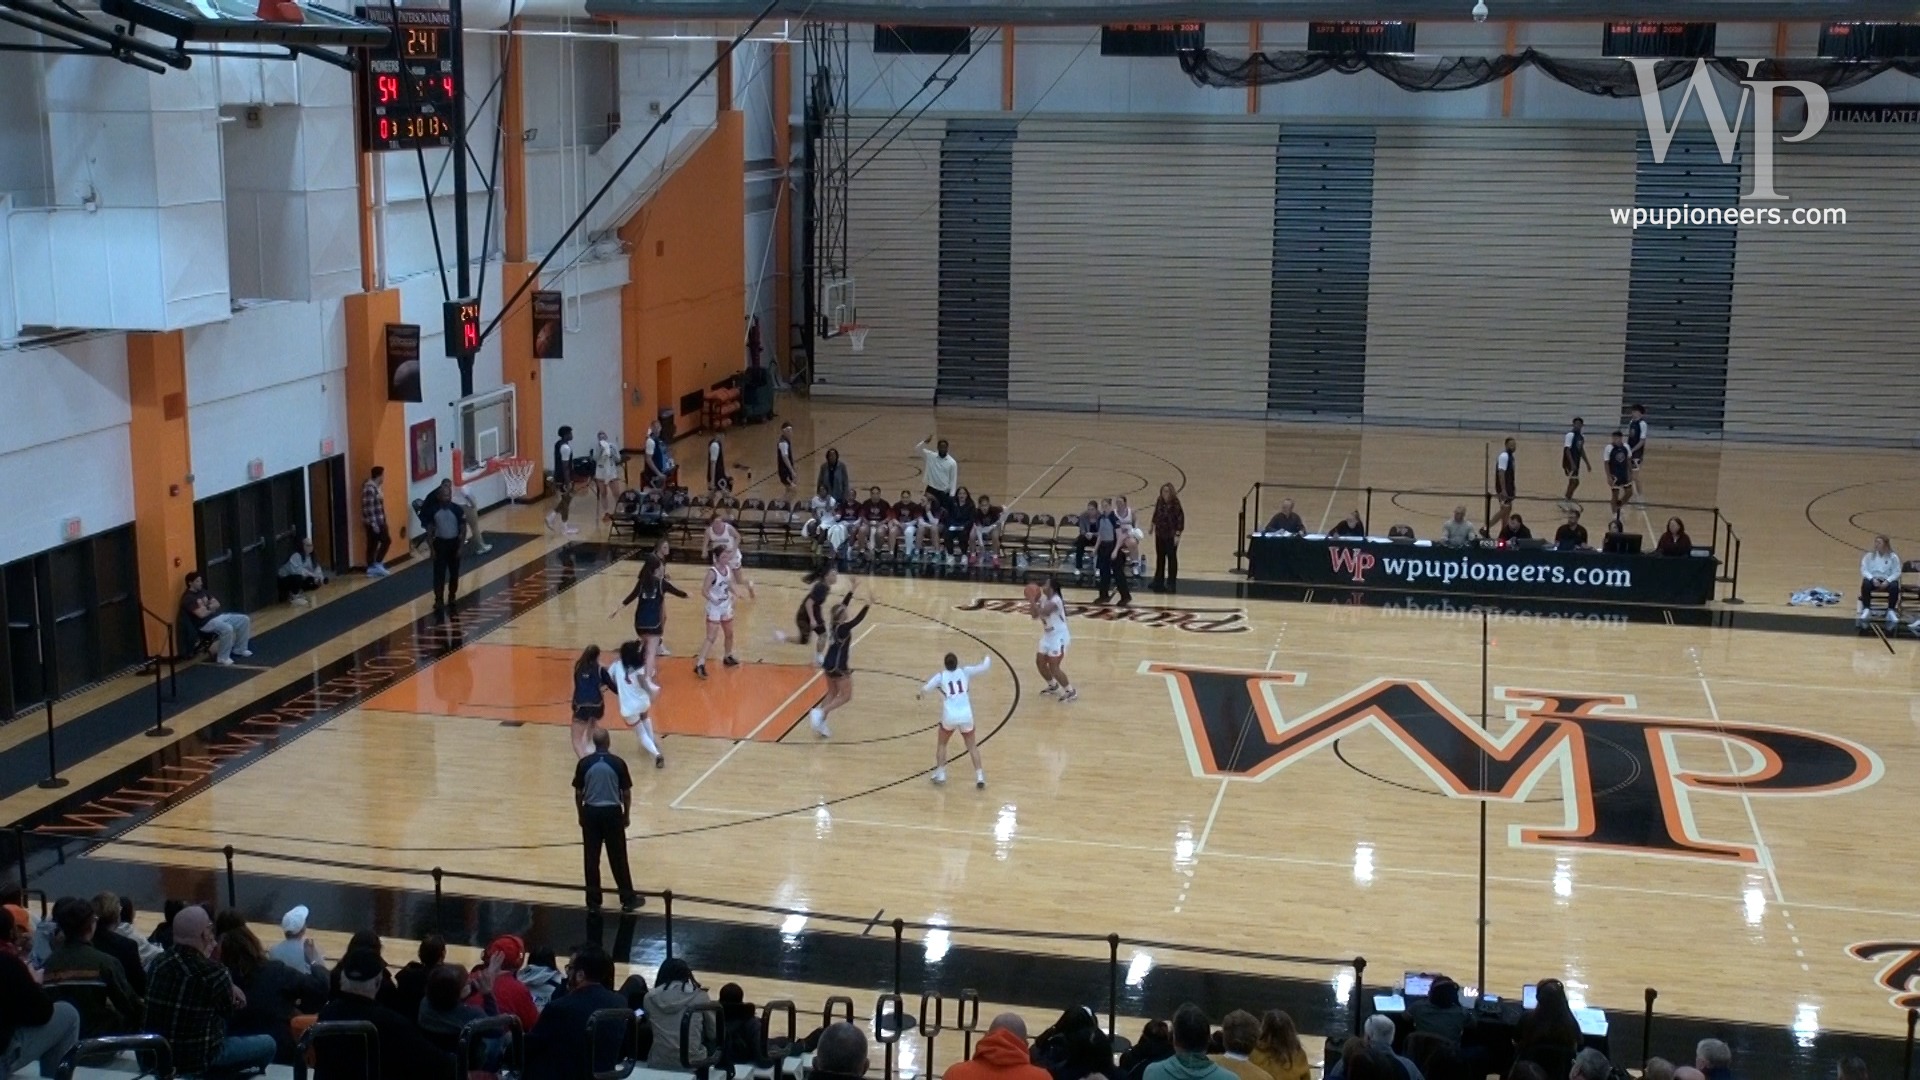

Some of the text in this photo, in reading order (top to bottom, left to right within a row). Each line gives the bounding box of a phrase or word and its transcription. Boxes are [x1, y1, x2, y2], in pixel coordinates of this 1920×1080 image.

[379, 76, 397, 101] 54
[1328, 545, 1632, 587] WP wpupioneers.com
[948, 679, 964, 695] 11
[1137, 660, 1885, 868] WP
